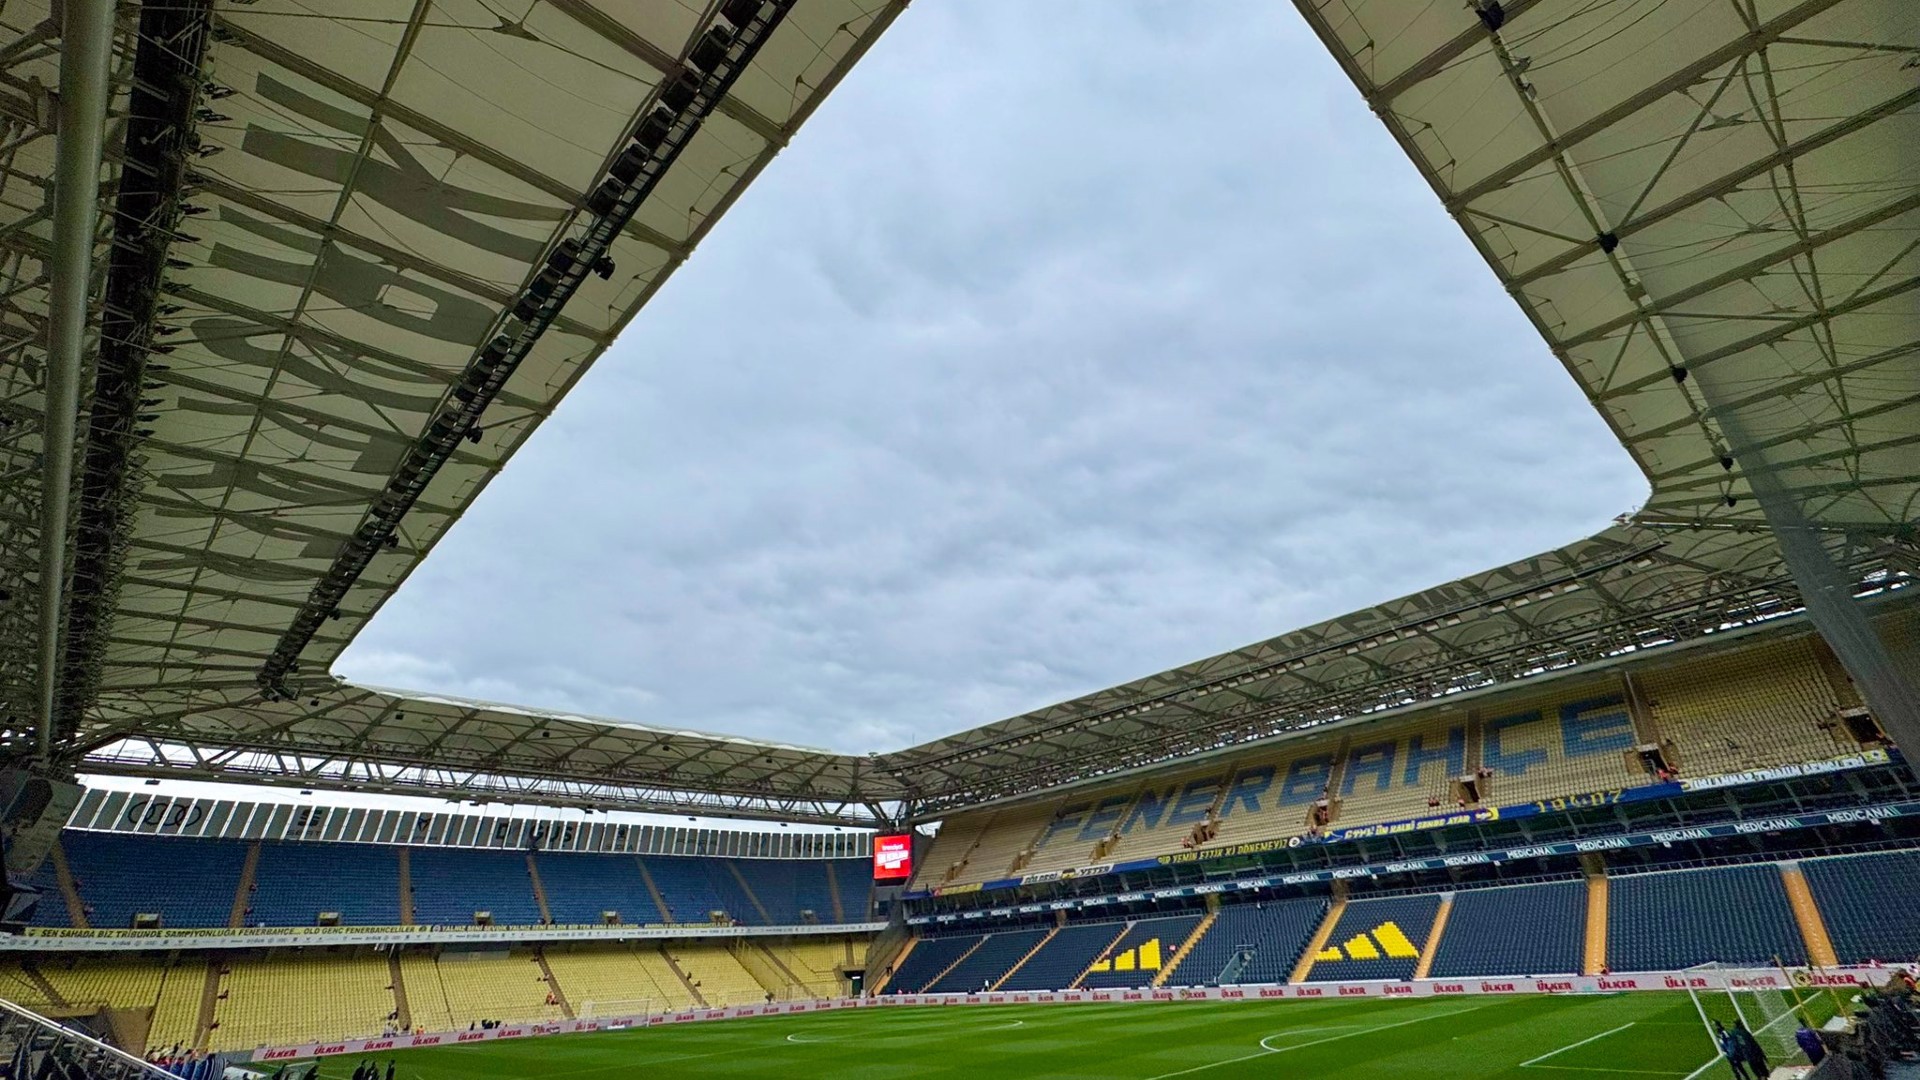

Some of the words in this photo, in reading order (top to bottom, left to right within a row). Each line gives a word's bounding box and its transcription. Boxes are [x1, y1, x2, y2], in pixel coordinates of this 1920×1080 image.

[1826, 807, 1893, 823] MEDICANA
[1734, 818, 1793, 833] MEDICANA
[1651, 829, 1702, 843] MEDICANA
[1576, 838, 1624, 851] MEDICANA
[1507, 847, 1550, 859] MEDICANA
[1445, 854, 1483, 866] MEDICANA
[1386, 862, 1423, 872] MEDICANA
[1333, 868, 1367, 878] MEDICANA
[1237, 880, 1266, 889] MEDICANA
[1283, 874, 1315, 885] MEDICANA
[1383, 983, 1413, 994] ÜLKER
[1433, 982, 1465, 993] ÜLKER
[1481, 980, 1515, 992] ÜLKER
[1537, 979, 1573, 992] ÜLKER
[1597, 977, 1638, 991] ÜLKER
[1221, 989, 1244, 998] ÜLKER
[1260, 987, 1284, 997] ÜLKER
[1296, 986, 1322, 996] ÜLKER
[1338, 985, 1367, 995] ÜLKER
[458, 1032, 484, 1041] ÜLKER
[498, 1029, 522, 1037] ÜLKER
[363, 1040, 394, 1050] ÜLKER
[412, 1036, 440, 1046] ÜLKER
[264, 1049, 297, 1060] ÜLKER
[313, 1045, 345, 1055] ÜLKER
